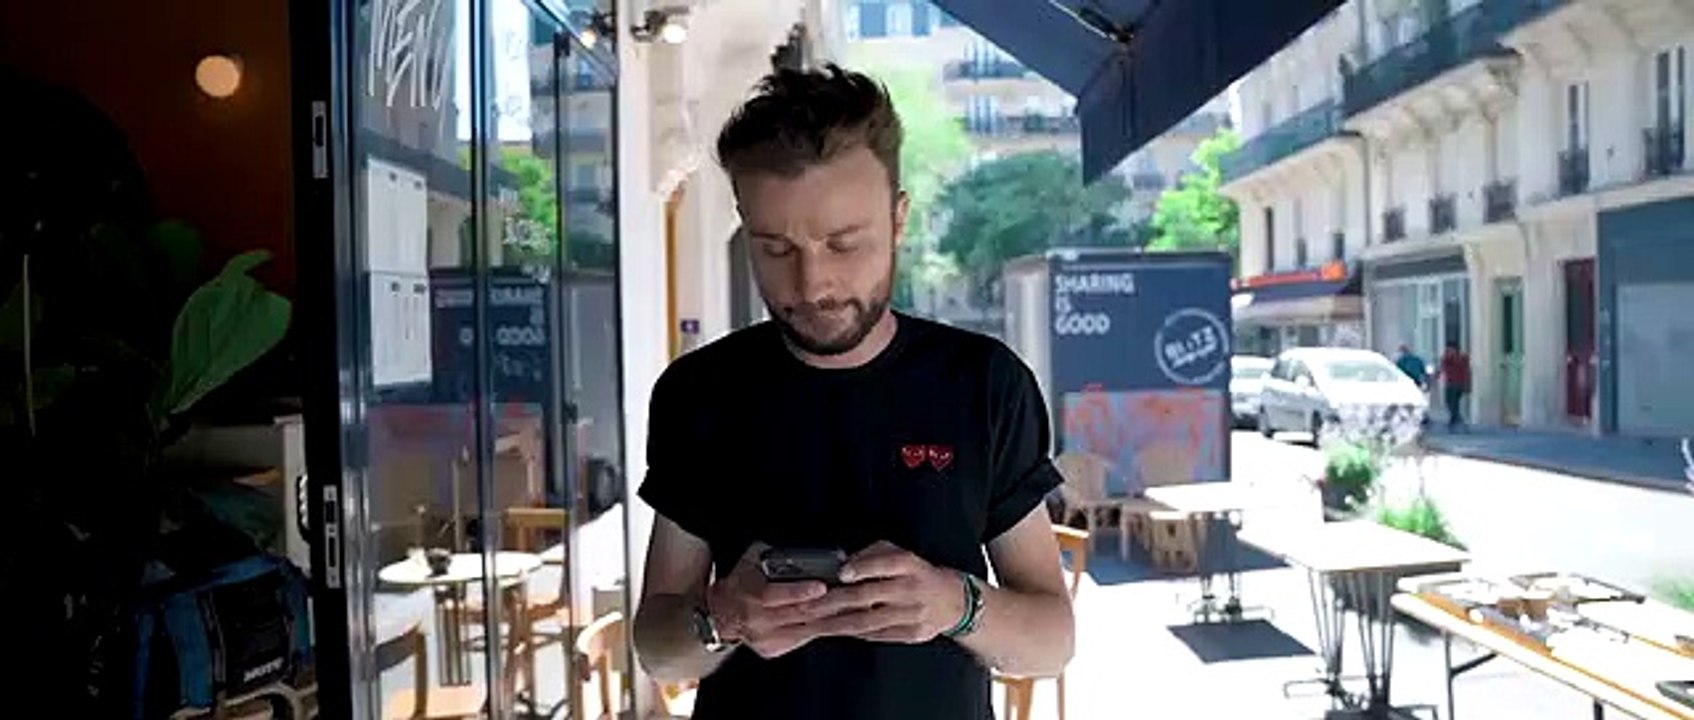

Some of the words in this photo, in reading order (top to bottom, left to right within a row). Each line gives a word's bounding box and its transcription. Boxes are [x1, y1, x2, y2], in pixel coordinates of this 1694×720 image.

[1055, 273, 1134, 293] SHARING
[1056, 294, 1071, 313] IS
[1055, 313, 1111, 335] GOOD
